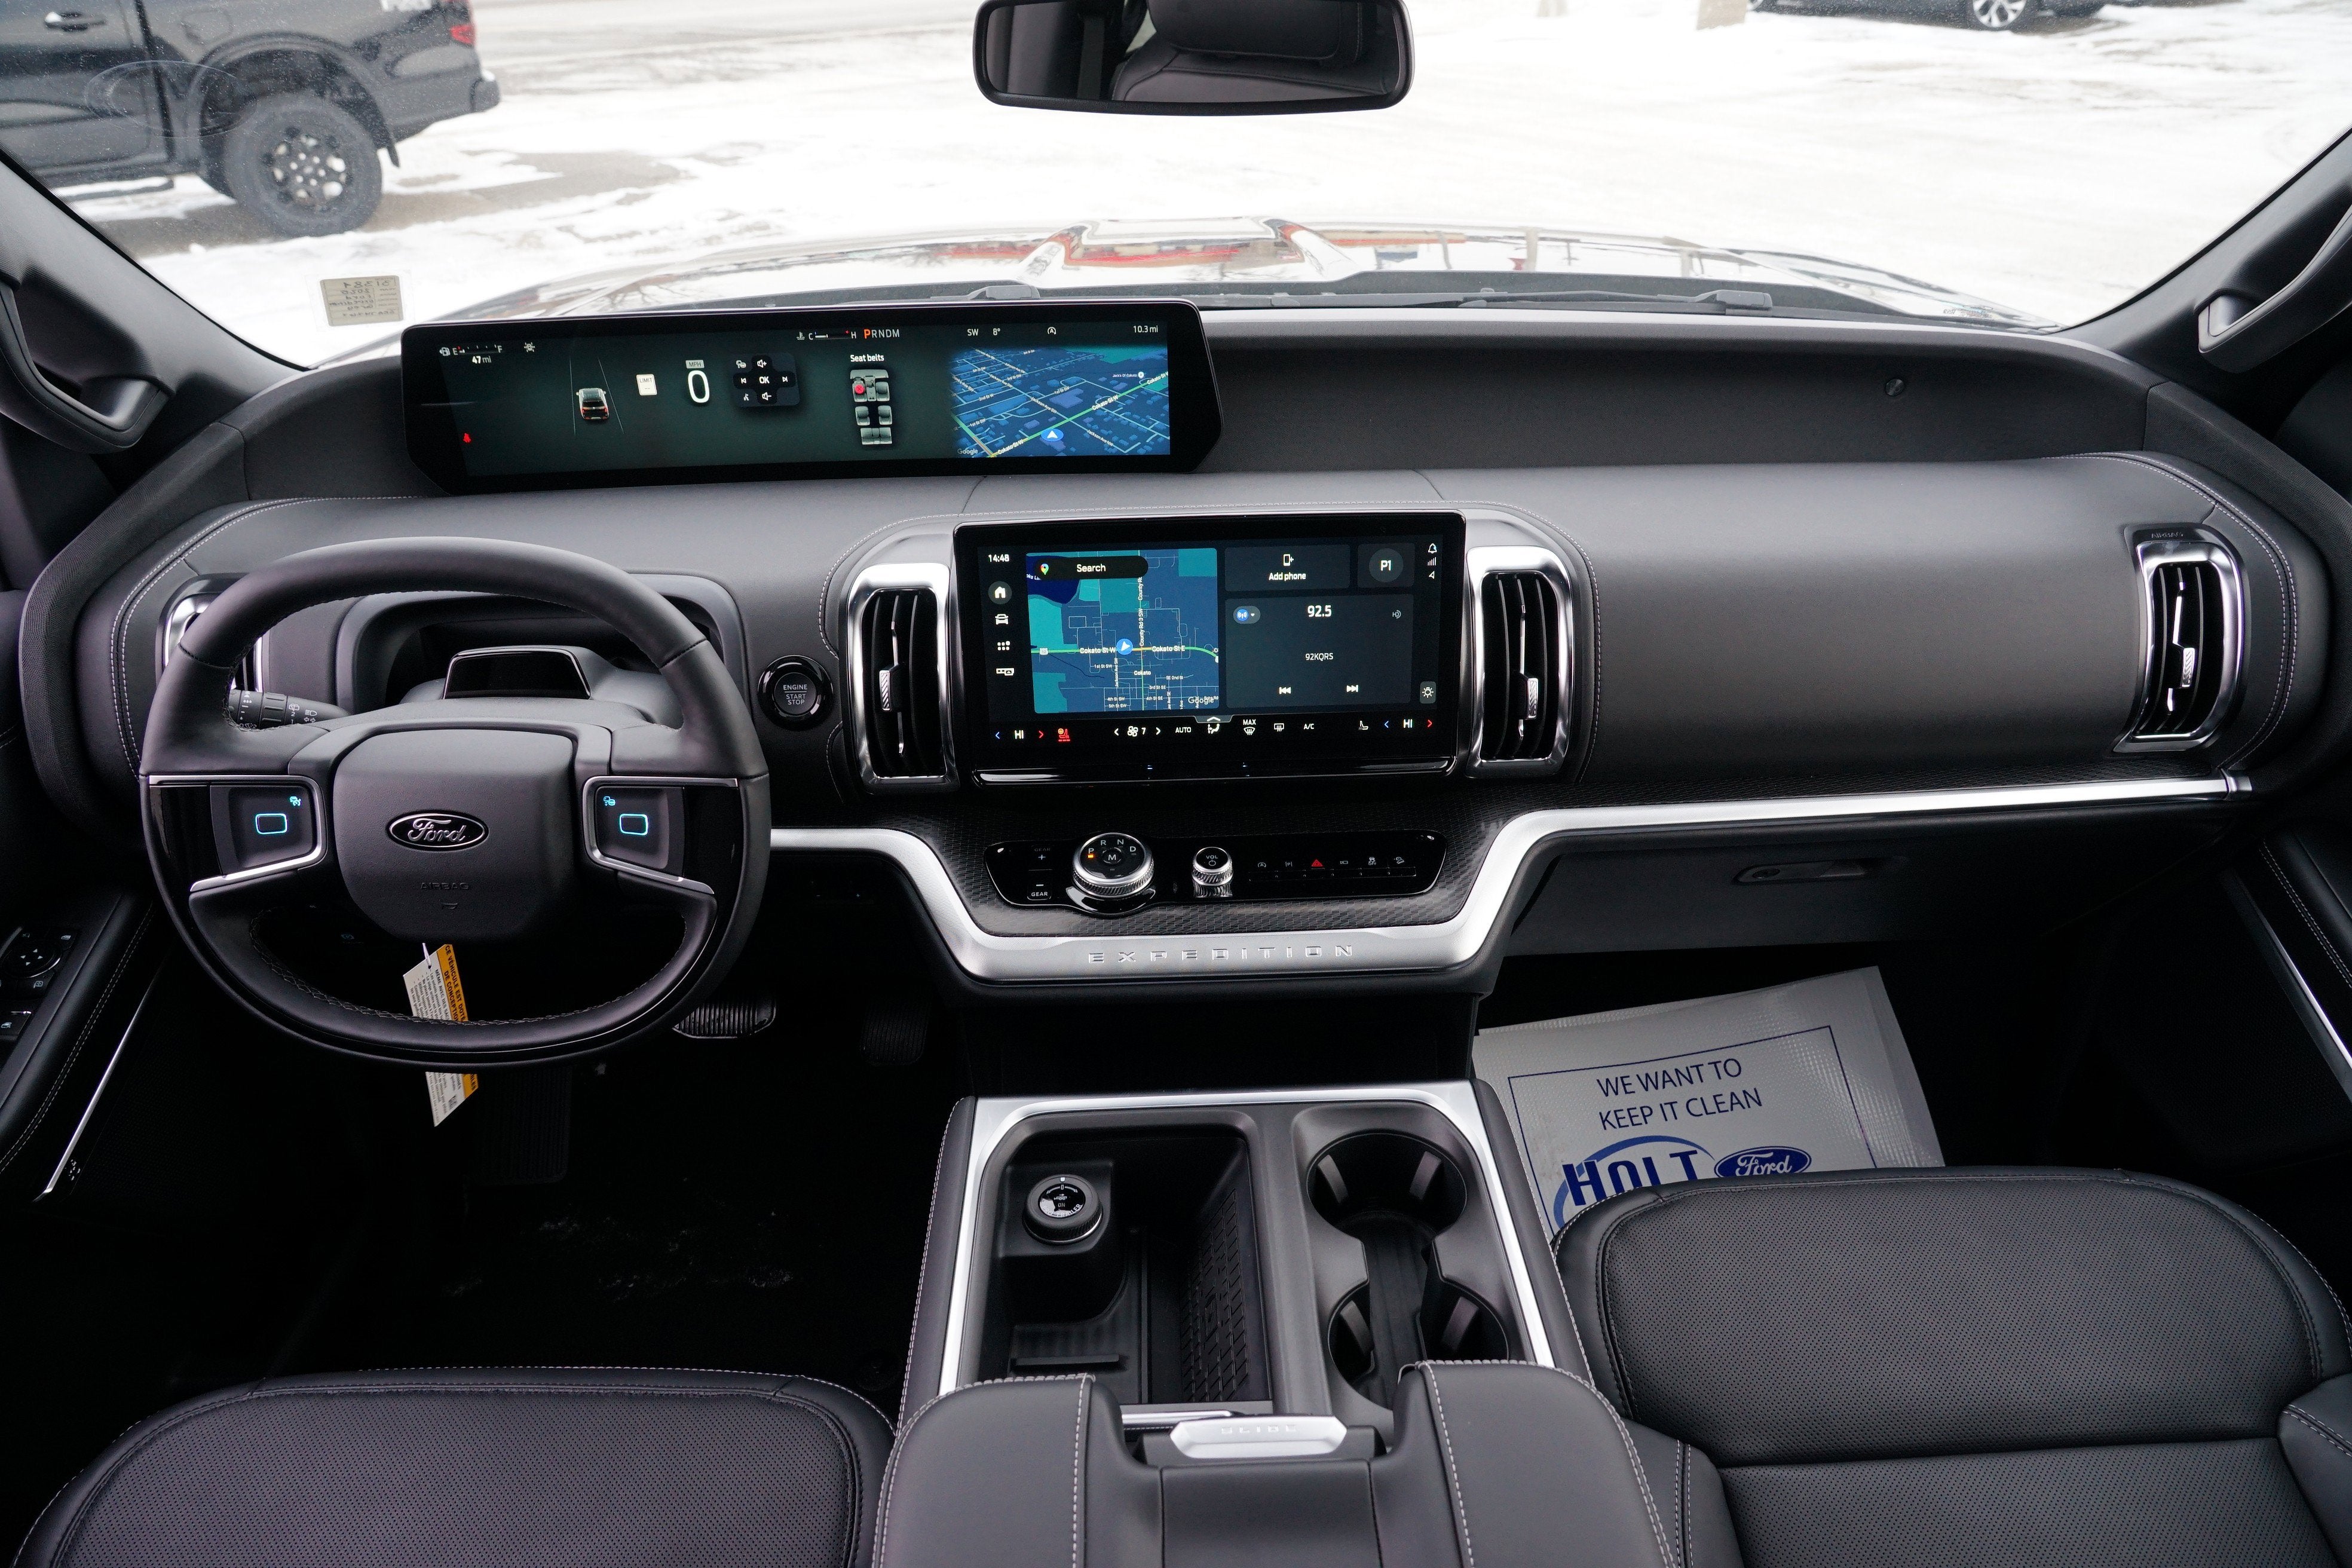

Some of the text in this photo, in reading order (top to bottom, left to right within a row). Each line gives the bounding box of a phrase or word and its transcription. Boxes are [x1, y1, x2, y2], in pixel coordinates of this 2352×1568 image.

[688, 370, 710, 403] 0
[1092, 400, 1108, 411] Cokato
[998, 444, 1013, 455] Cokato
[988, 554, 1010, 562] 14:48
[1076, 564, 1106, 572] Search
[1380, 560, 1392, 571] P1
[1269, 572, 1306, 581] Add phone
[1138, 608, 1144, 617] SW
[1307, 605, 1332, 617] 92.5
[1305, 653, 1334, 662] 92KQRS
[1403, 719, 1413, 728] HI
[1014, 730, 1024, 739] HI
[408, 818, 467, 842] Ford
[421, 882, 470, 890] AIRBAG
[445, 945, 452, 956] CE
[1088, 945, 1352, 964] EXPEDITION
[444, 970, 450, 981] DE
[1597, 1058, 1742, 1097] WE WANT TO
[1599, 1088, 1763, 1130] KEEP IT CLEAN
[1735, 1152, 1793, 1176] Ford
